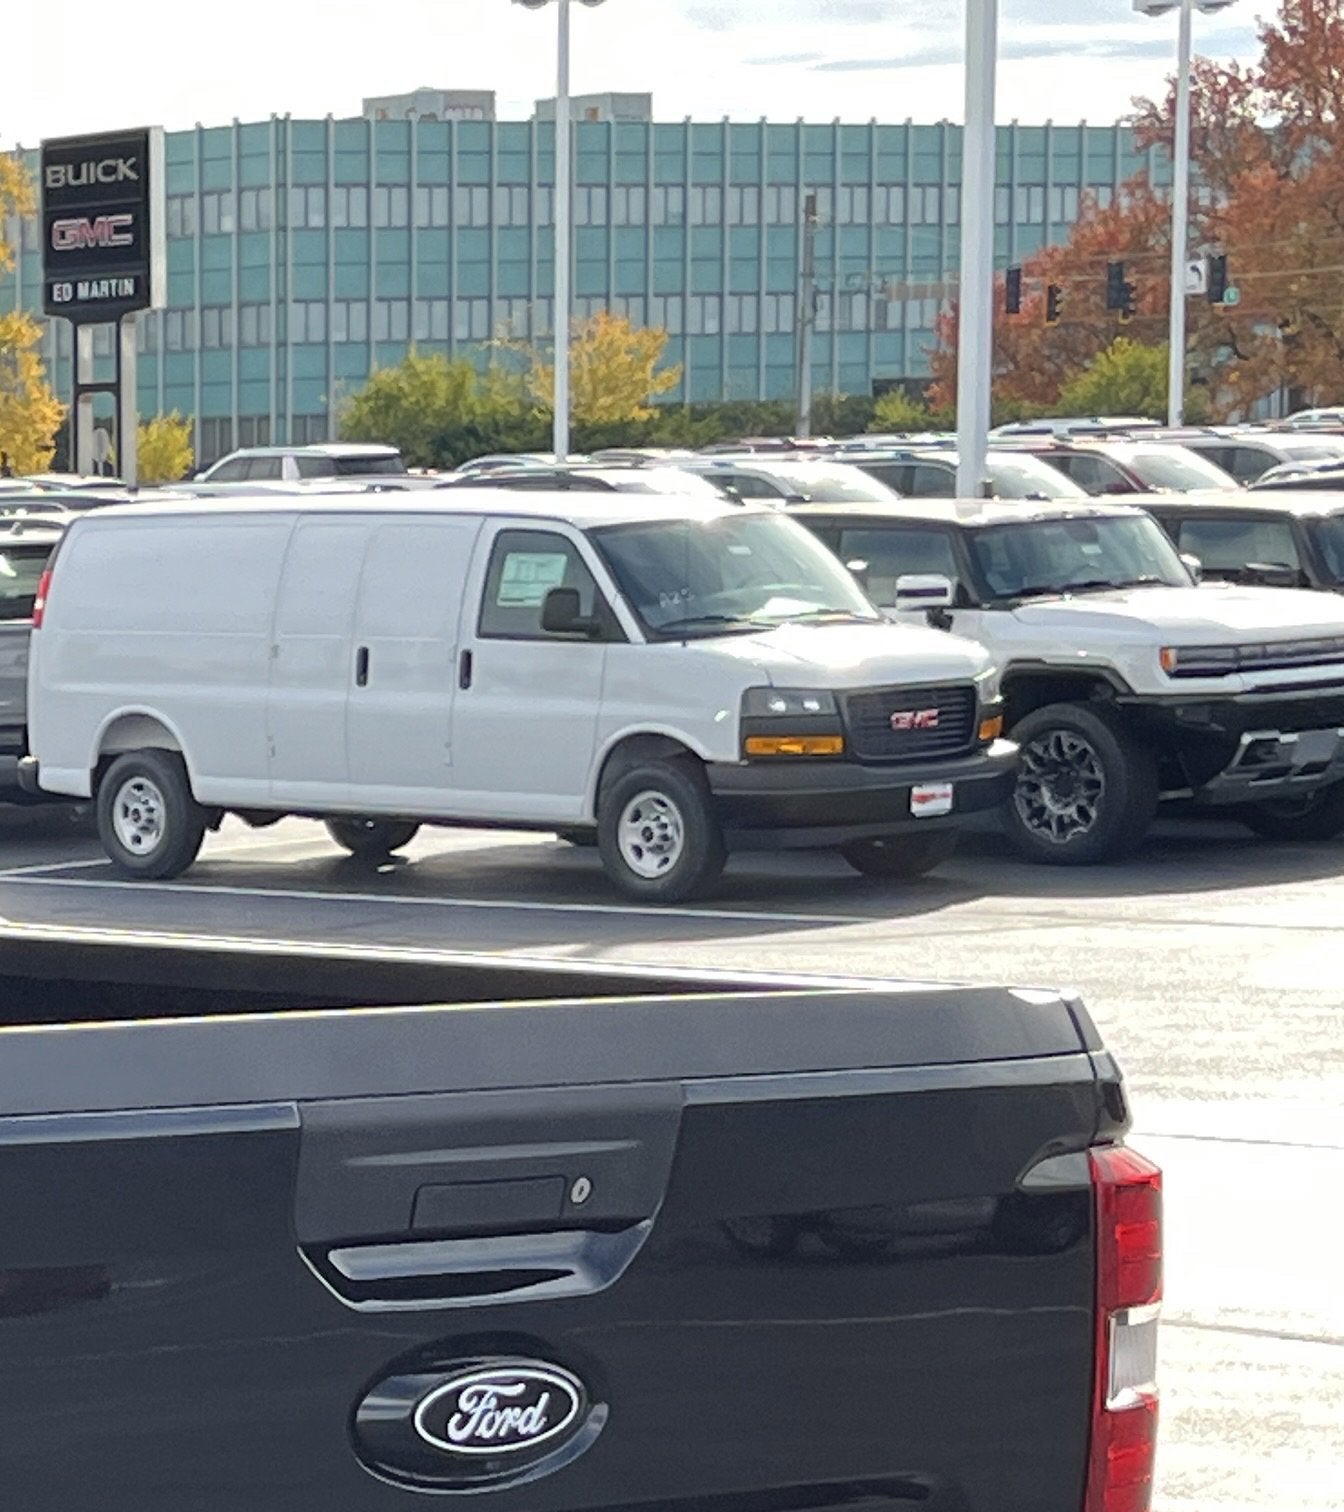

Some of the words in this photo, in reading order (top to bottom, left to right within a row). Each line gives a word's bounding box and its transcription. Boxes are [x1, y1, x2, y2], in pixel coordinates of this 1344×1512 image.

[45, 157, 139, 188] BUICK
[52, 214, 134, 250] GMC
[52, 283, 73, 302] ED
[77, 278, 135, 299] MARTIN
[446, 1382, 550, 1443] Ford
